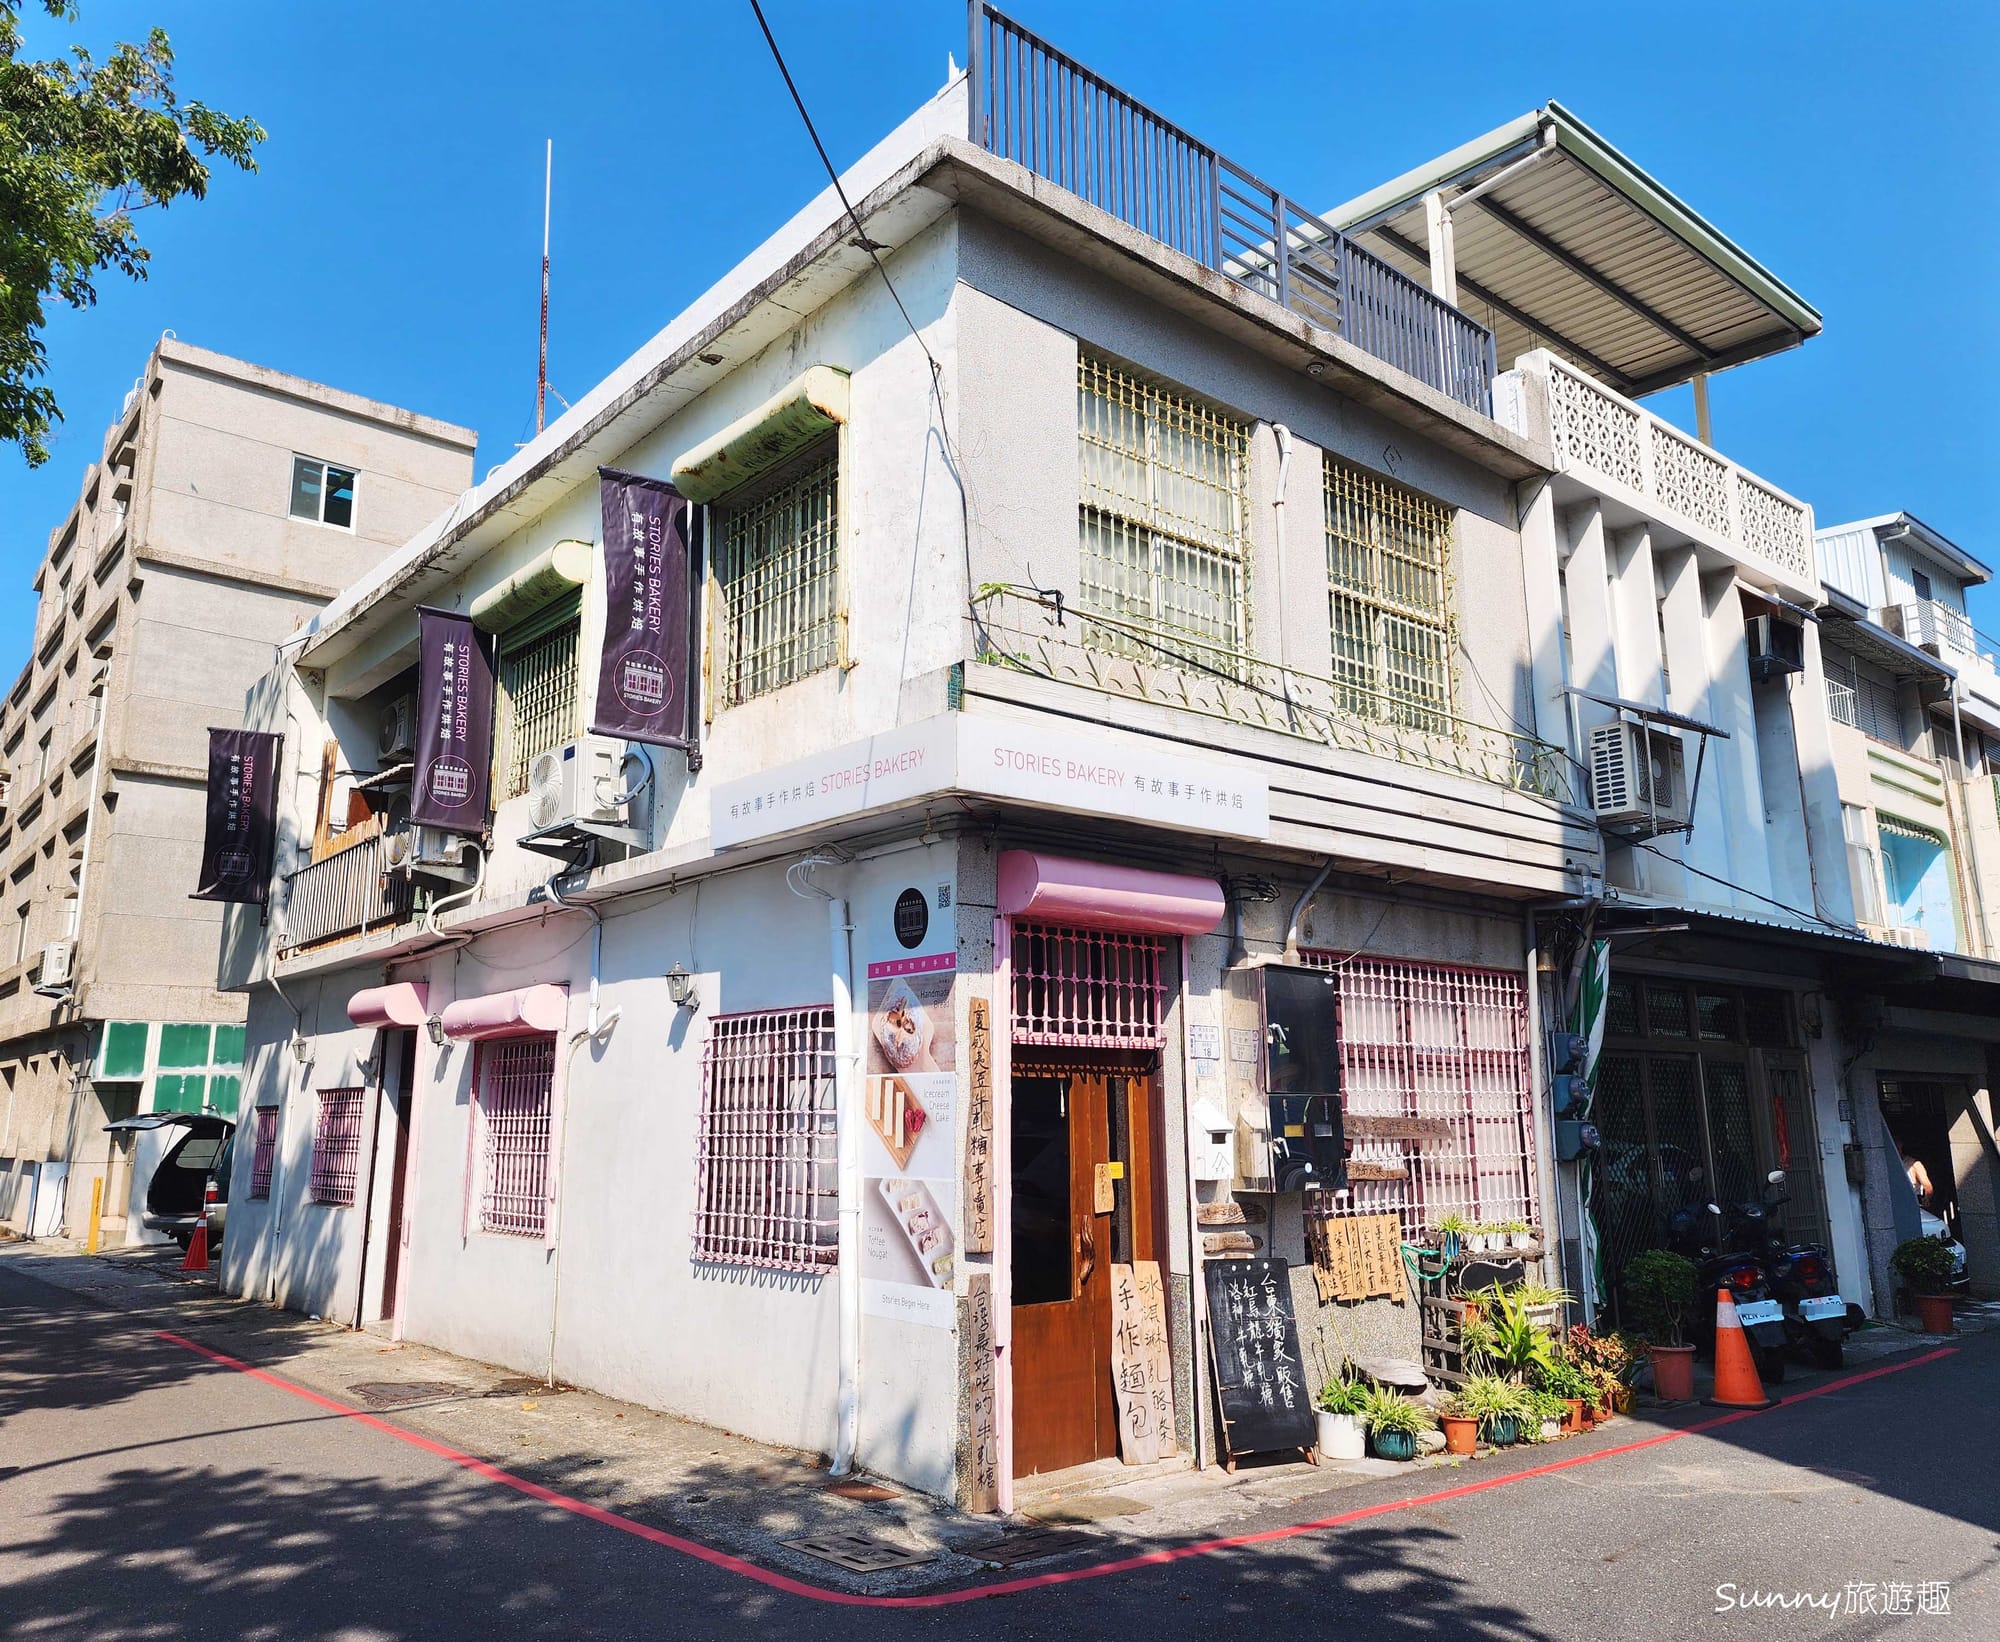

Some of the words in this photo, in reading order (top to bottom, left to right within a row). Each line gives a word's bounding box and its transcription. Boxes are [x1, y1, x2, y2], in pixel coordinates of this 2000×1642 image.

[631, 512, 646, 630] 有故事手作烘焙
[648, 515, 662, 574] STORIES
[648, 577, 662, 635] BAKERY
[440, 642, 455, 740] 有故事手作烘焙
[456, 645, 469, 695] STORIES
[455, 696, 468, 742] BAKERY
[241, 755, 254, 795] STORIES
[729, 781, 816, 819] 有故事手作烘焙
[820, 763, 871, 794] STORIES
[874, 747, 927, 779] BAKERY
[994, 747, 1062, 777] STORIES
[1066, 761, 1126, 788] BAKERY
[1133, 774, 1244, 810] 有故事手作烘焙
[240, 796, 253, 833] BAKERY
[1116, 1279, 1153, 1439] 手作麵包
